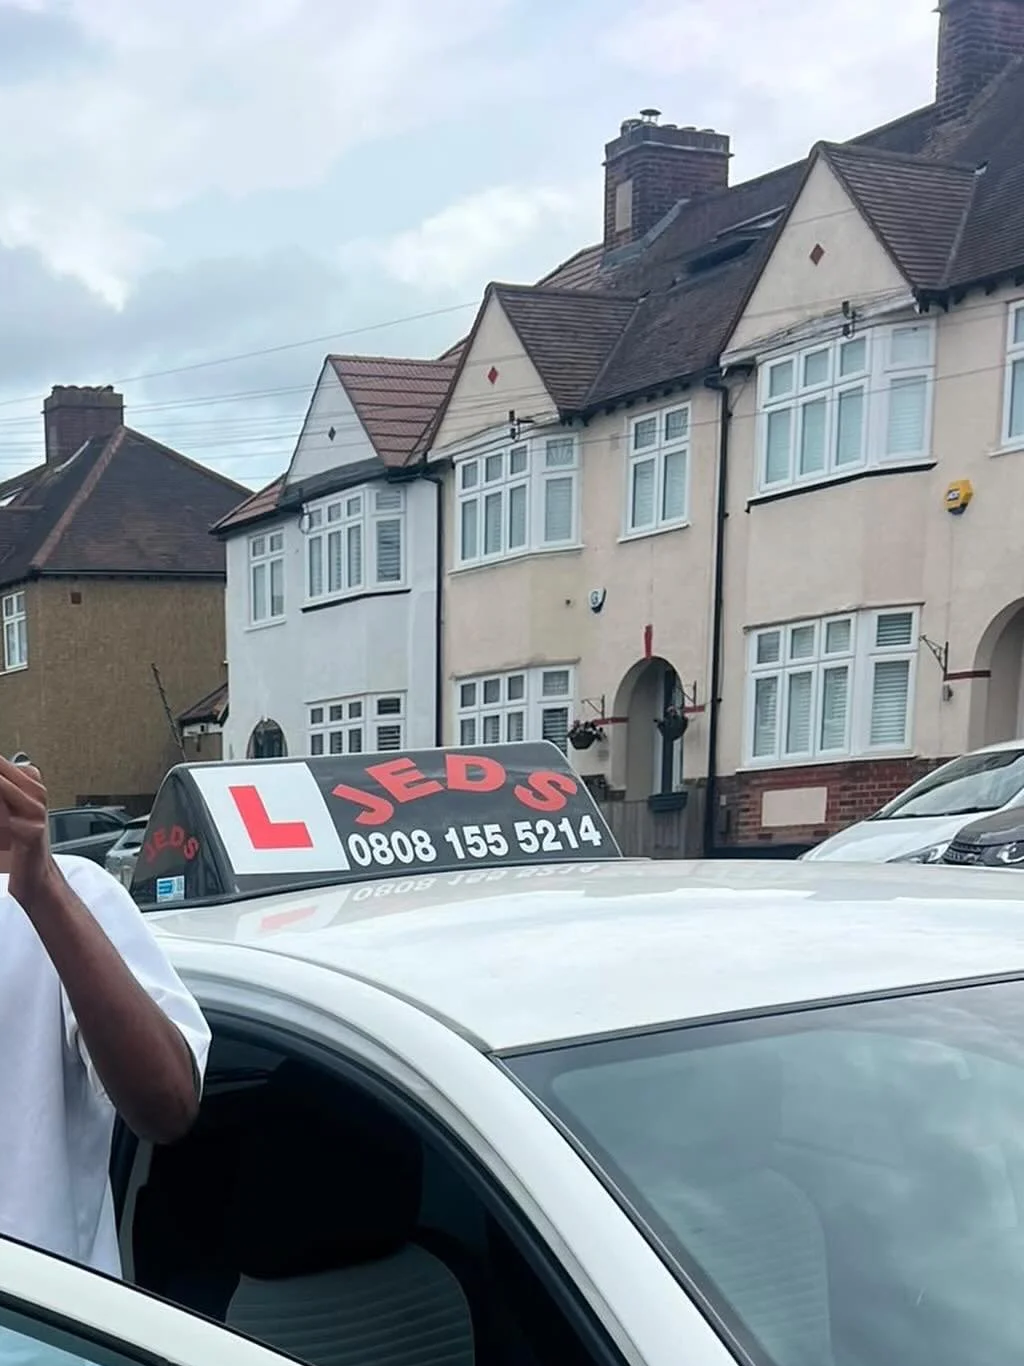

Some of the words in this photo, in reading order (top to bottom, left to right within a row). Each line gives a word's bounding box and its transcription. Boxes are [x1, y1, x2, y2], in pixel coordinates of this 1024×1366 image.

[228, 785, 314, 850] L
[331, 753, 578, 826] JEDS
[144, 825, 200, 863] JEDS
[347, 829, 437, 867] 0808
[445, 823, 509, 860] 155
[514, 814, 602, 854] 5214
